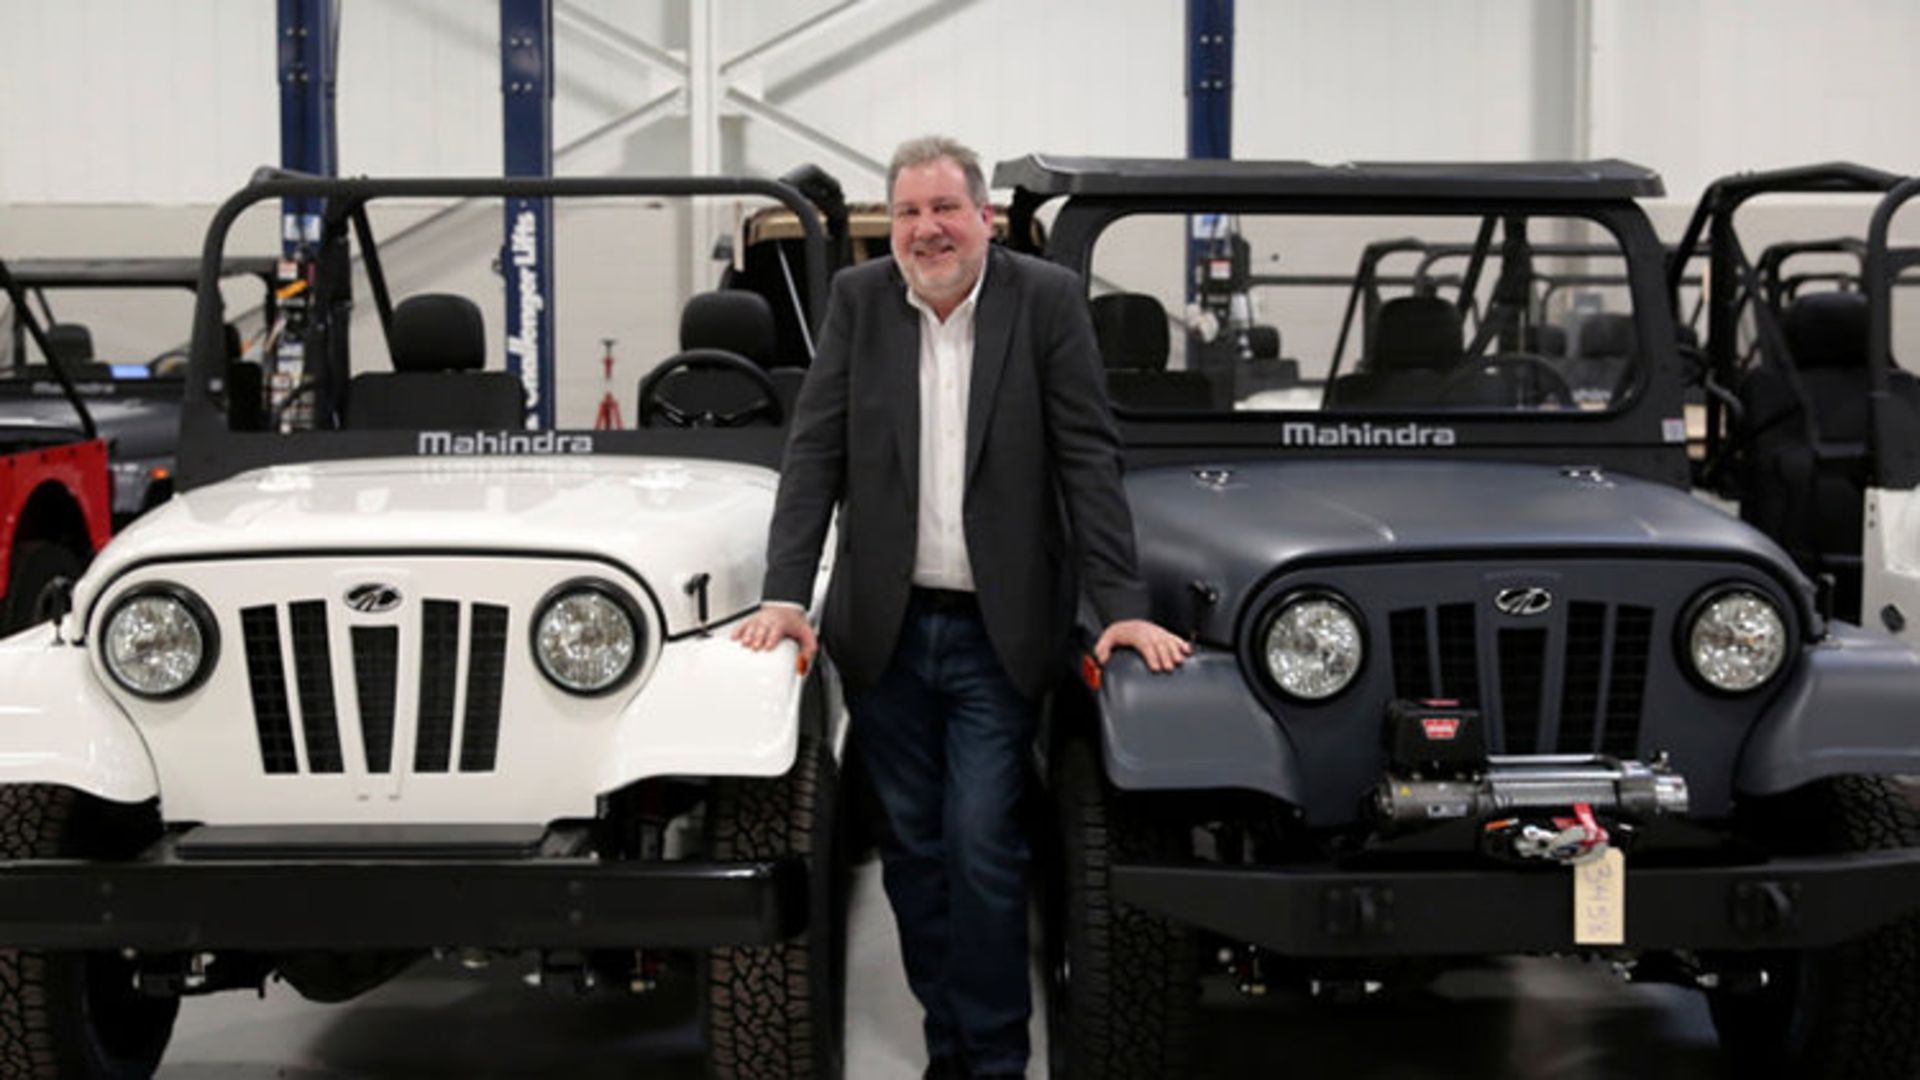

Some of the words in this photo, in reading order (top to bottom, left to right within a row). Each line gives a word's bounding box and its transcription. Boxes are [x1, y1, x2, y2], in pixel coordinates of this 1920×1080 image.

[511, 211, 536, 266] Lifts
[419, 432, 592, 454] Mahindra
[1283, 422, 1456, 446] Mahindra
